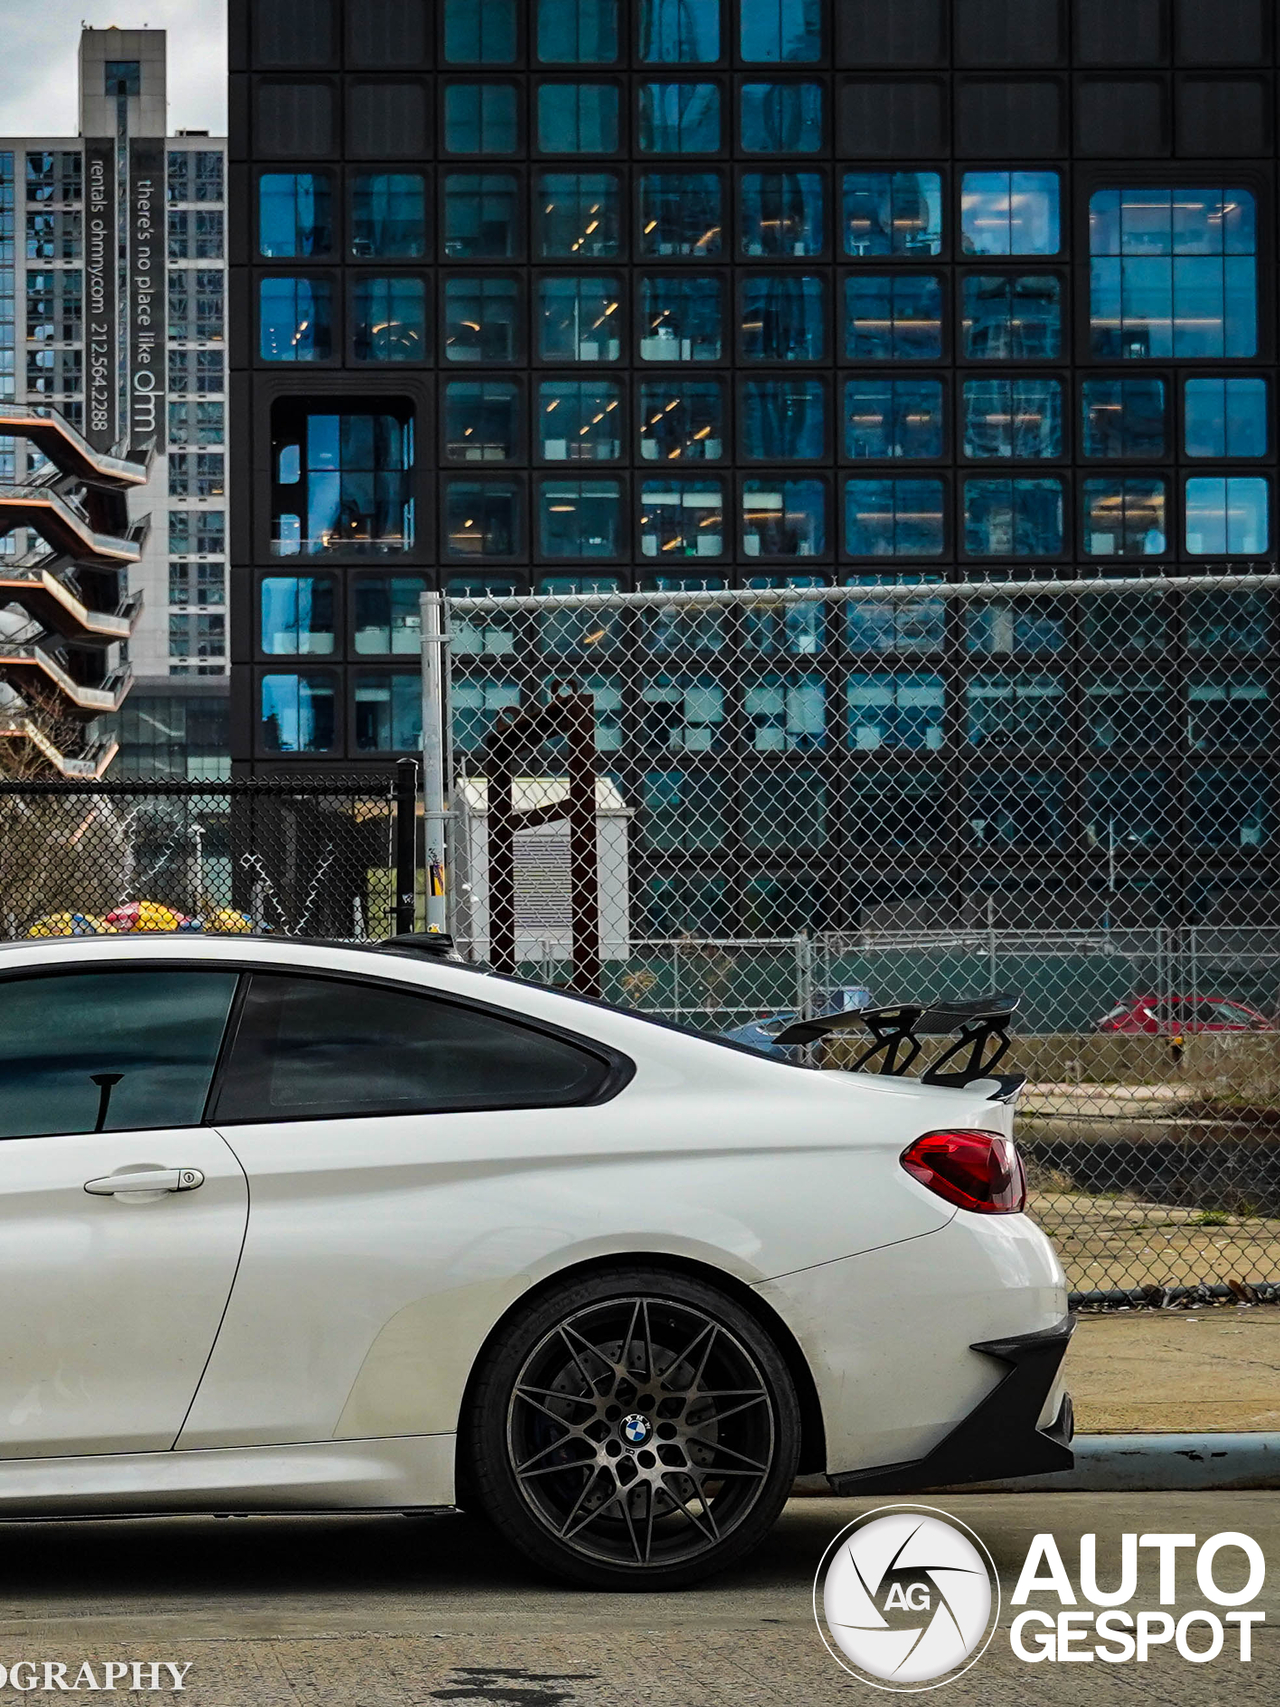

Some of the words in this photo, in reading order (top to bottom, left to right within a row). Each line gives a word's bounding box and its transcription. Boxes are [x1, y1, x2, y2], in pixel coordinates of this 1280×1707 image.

[90, 160, 108, 212] rentals
[137, 180, 155, 240] there's
[87, 220, 108, 313] ohmny.com
[137, 247, 151, 270] no
[134, 277, 155, 326] place
[137, 333, 155, 364] like
[91, 323, 108, 431] 212.564.2288
